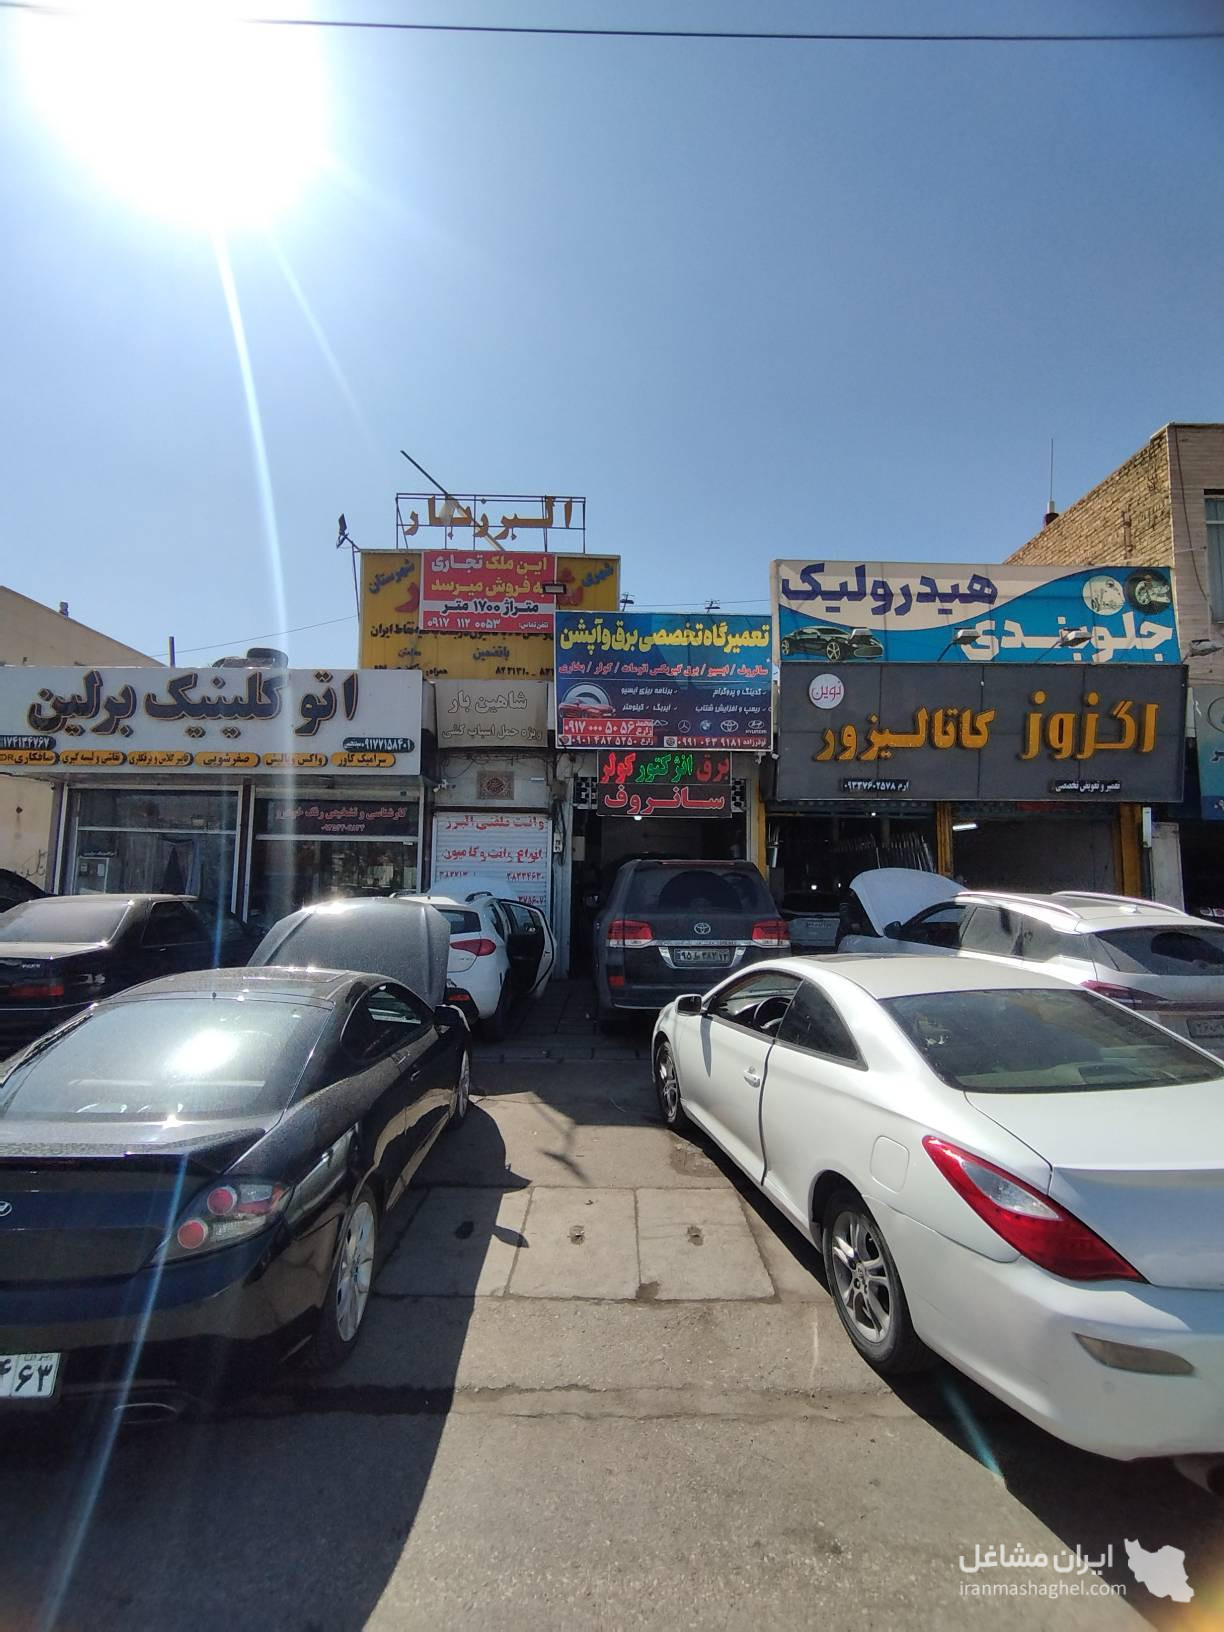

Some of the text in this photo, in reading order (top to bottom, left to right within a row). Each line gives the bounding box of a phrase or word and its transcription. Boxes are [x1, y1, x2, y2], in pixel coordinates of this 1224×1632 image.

[431, 554, 548, 575] این ملک تجاری
[431, 578, 483, 596] میرسد
[485, 577, 530, 597] فروش
[781, 561, 998, 617] هیدرولیک
[441, 598, 539, 617] متراژ ۱۷۰۰ متر
[428, 617, 449, 628] ۰۹۱۷
[475, 617, 500, 629] ۰۰۵۳
[560, 618, 603, 655] آپشن
[601, 629, 611, 651] و
[612, 620, 638, 652] برق
[639, 622, 703, 653] تخصصی
[703, 622, 770, 654] تعمیرگاه
[959, 611, 1174, 663] جلوبندی
[558, 661, 586, 674] بخاری
[448, 689, 528, 714] شاهین بار
[811, 681, 841, 702] نوین
[26, 669, 360, 739] اتو کلینیک برلین
[564, 720, 586, 734] ۰۹۱۷
[812, 705, 997, 762] کاتالیزور
[1018, 689, 1160, 761] اگزوز
[14, 752, 54, 765] صافکاری
[297, 753, 323, 766] واکس
[357, 753, 387, 766] سرامیک
[600, 752, 636, 784] کولر
[696, 753, 730, 783] برق
[604, 784, 725, 815] سانروف
[512, 816, 545, 831] وانت
[516, 847, 543, 864] انواع
